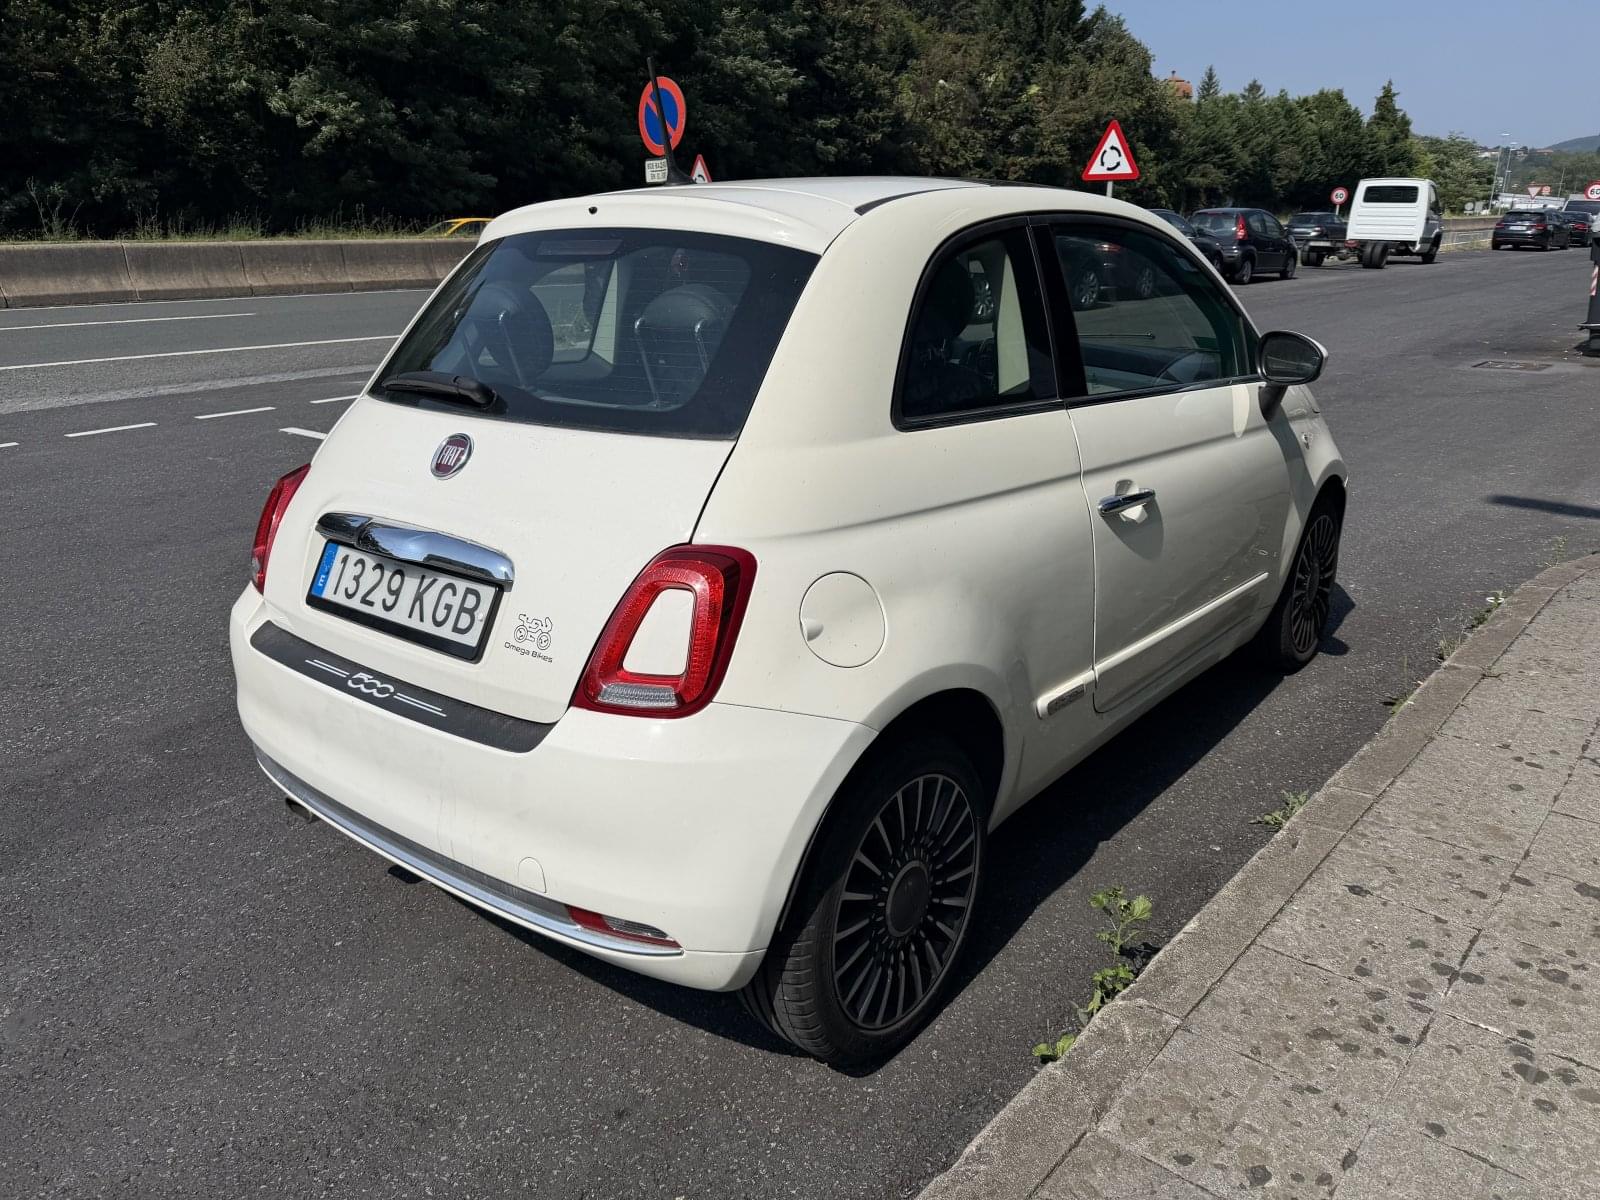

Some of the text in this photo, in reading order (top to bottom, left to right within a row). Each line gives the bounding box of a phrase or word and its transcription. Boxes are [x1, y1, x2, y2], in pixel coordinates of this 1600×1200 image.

[438, 445, 464, 466] FIAT
[333, 554, 482, 635] 1329 KGB
[504, 641, 553, 663] Omega Bikes
[347, 672, 394, 698] 500
